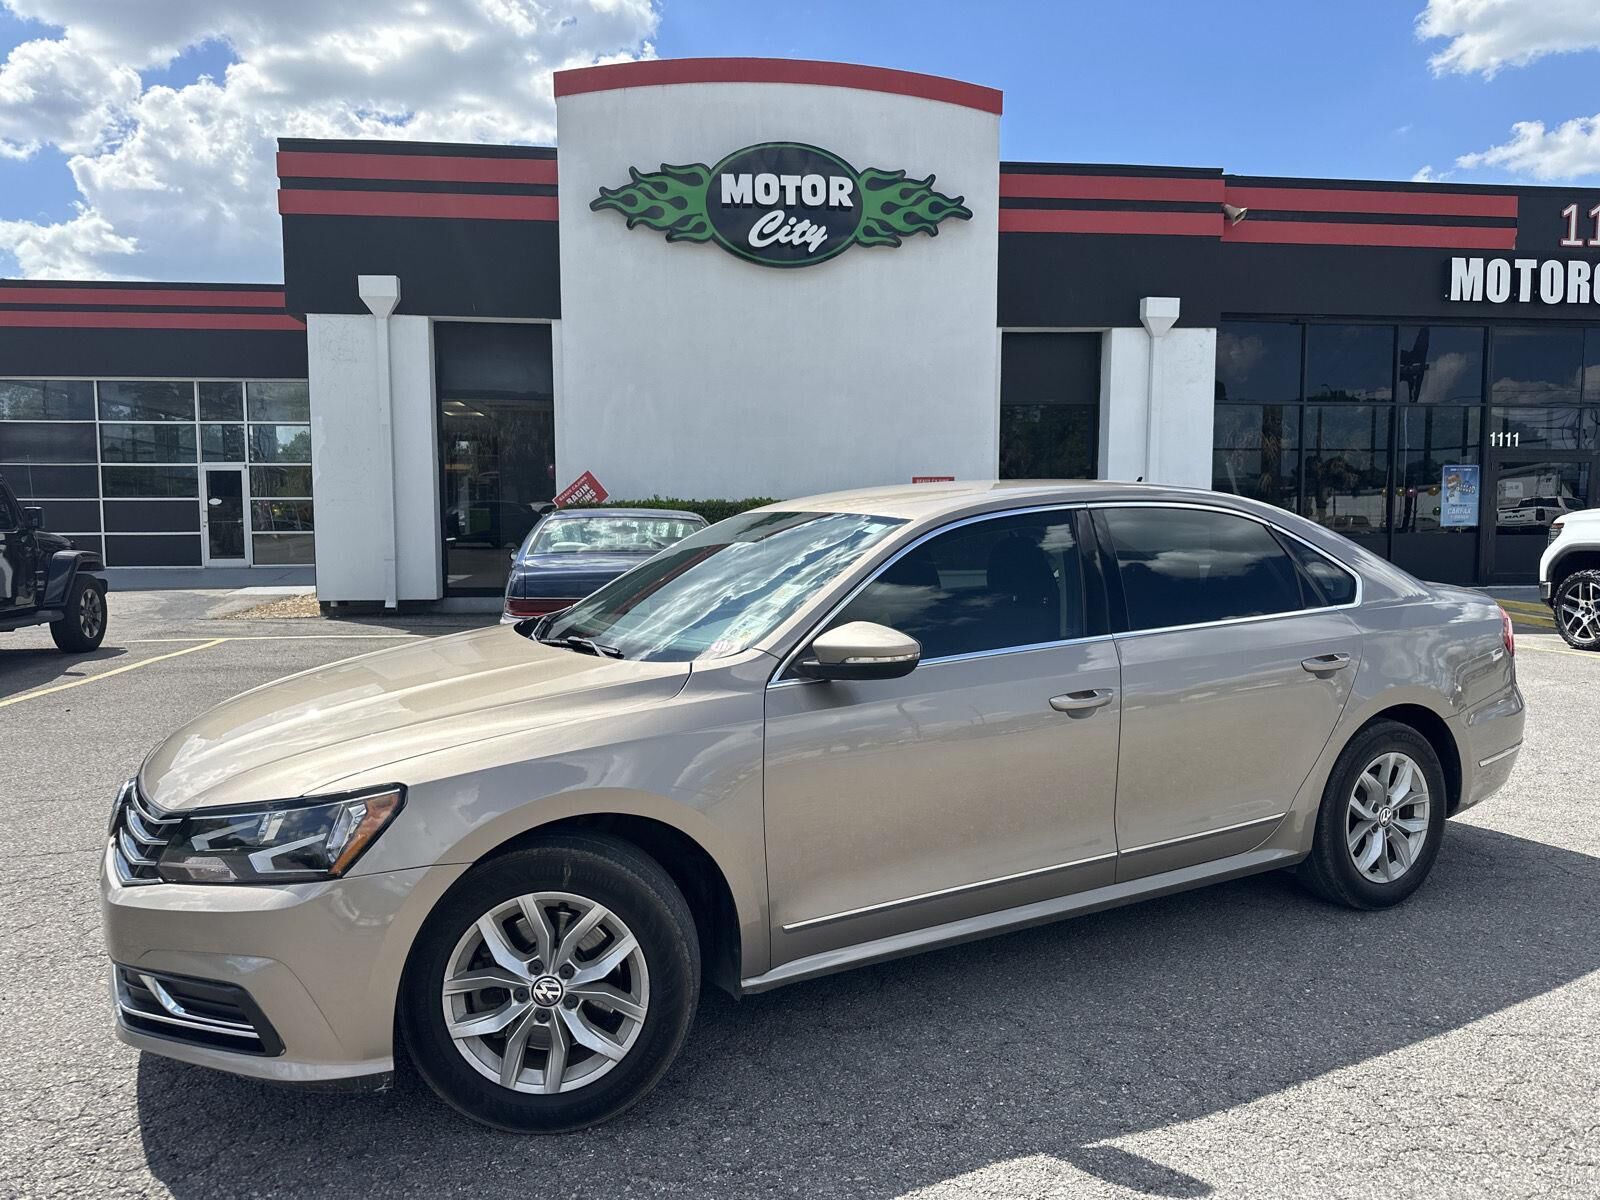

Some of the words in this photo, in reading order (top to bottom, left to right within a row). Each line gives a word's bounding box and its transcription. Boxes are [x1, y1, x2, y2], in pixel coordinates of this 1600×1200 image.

[721, 172, 854, 208] MOTOR
[748, 209, 828, 254] City
[1489, 431, 1520, 448] 1111
